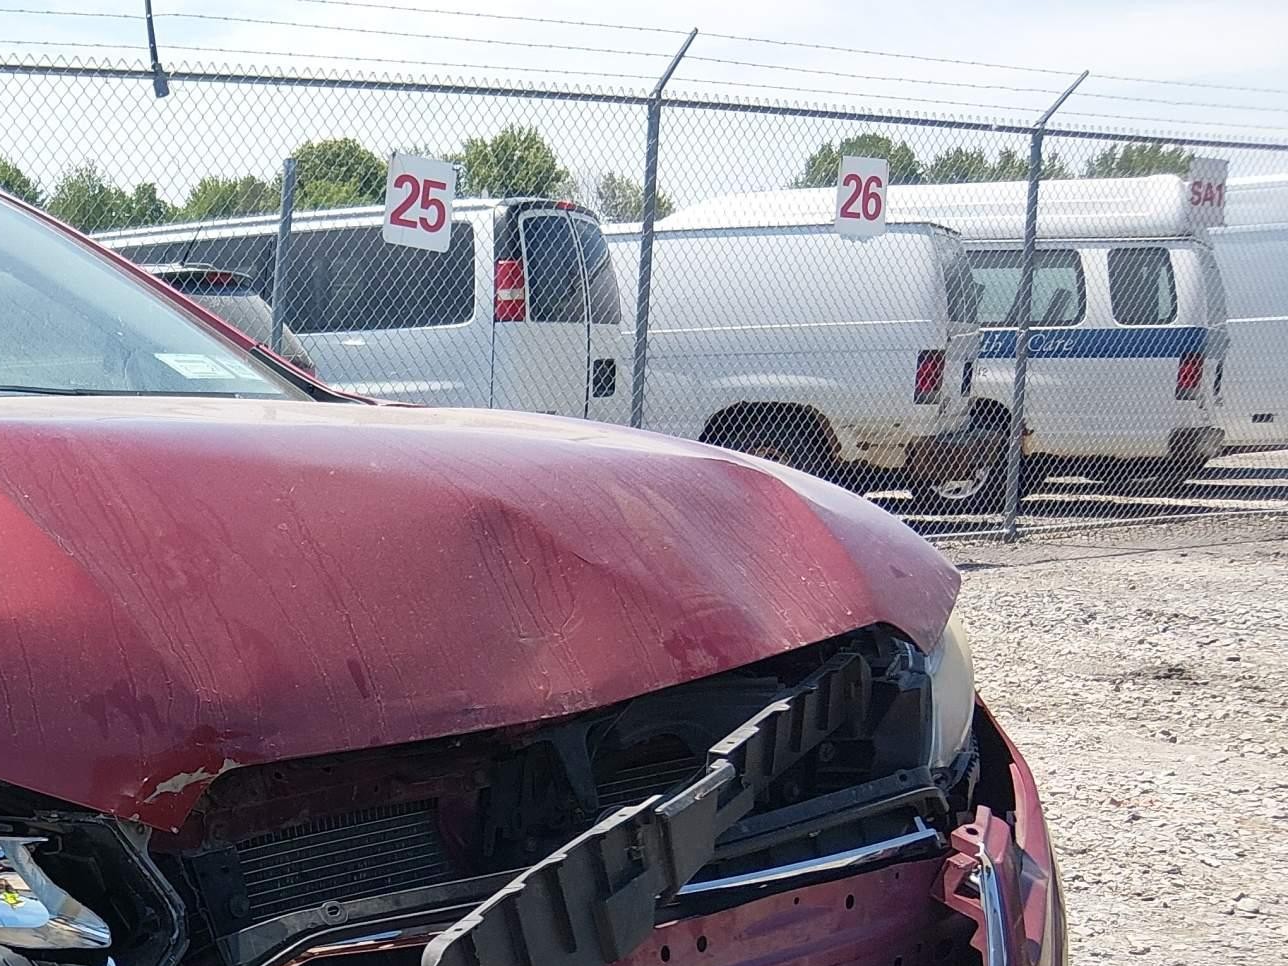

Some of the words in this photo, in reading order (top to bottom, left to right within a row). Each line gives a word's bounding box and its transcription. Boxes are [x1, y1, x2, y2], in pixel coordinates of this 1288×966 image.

[389, 174, 447, 233] 25
[839, 173, 883, 221] 26
[1190, 181, 1223, 207] SA1
[1027, 333, 1074, 352] Care
